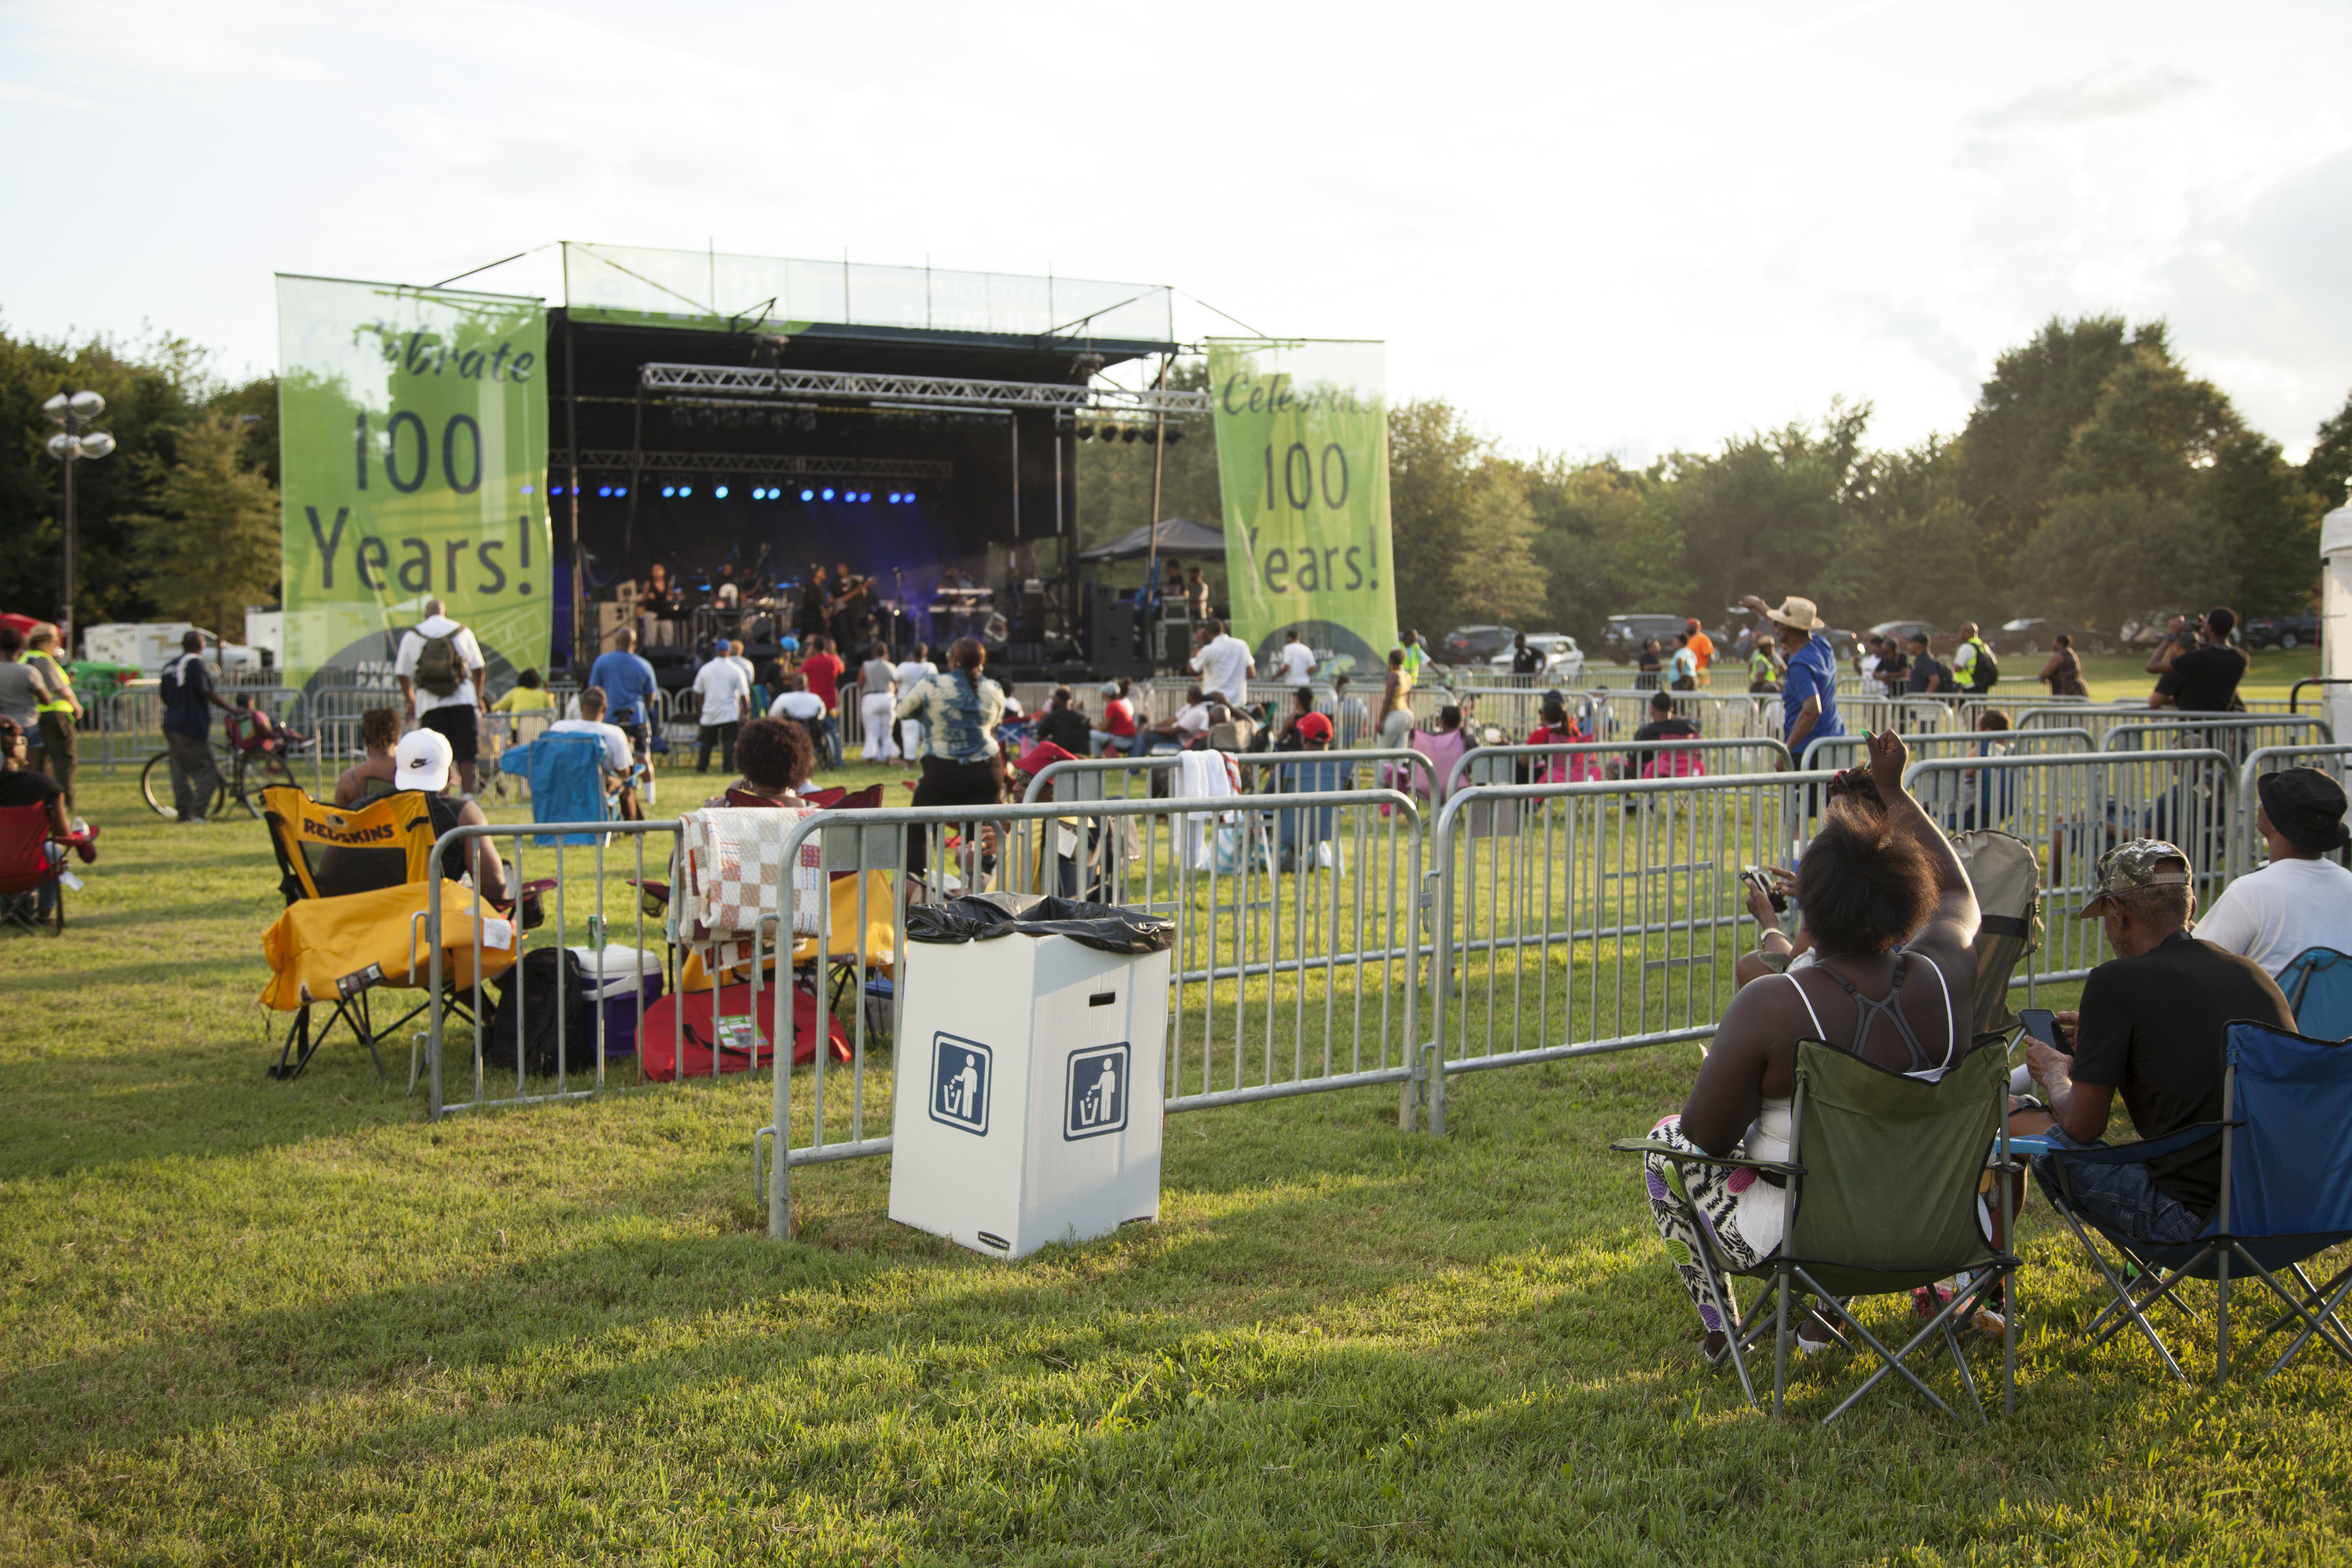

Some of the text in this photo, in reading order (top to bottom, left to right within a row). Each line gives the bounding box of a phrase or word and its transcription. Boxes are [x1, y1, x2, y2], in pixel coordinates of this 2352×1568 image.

[354, 410, 483, 494] 100
[1264, 441, 1349, 510] 100
[305, 505, 533, 596] Years!
[303, 818, 395, 844] REDSKINS
[979, 1234, 998, 1245] BANKERS
